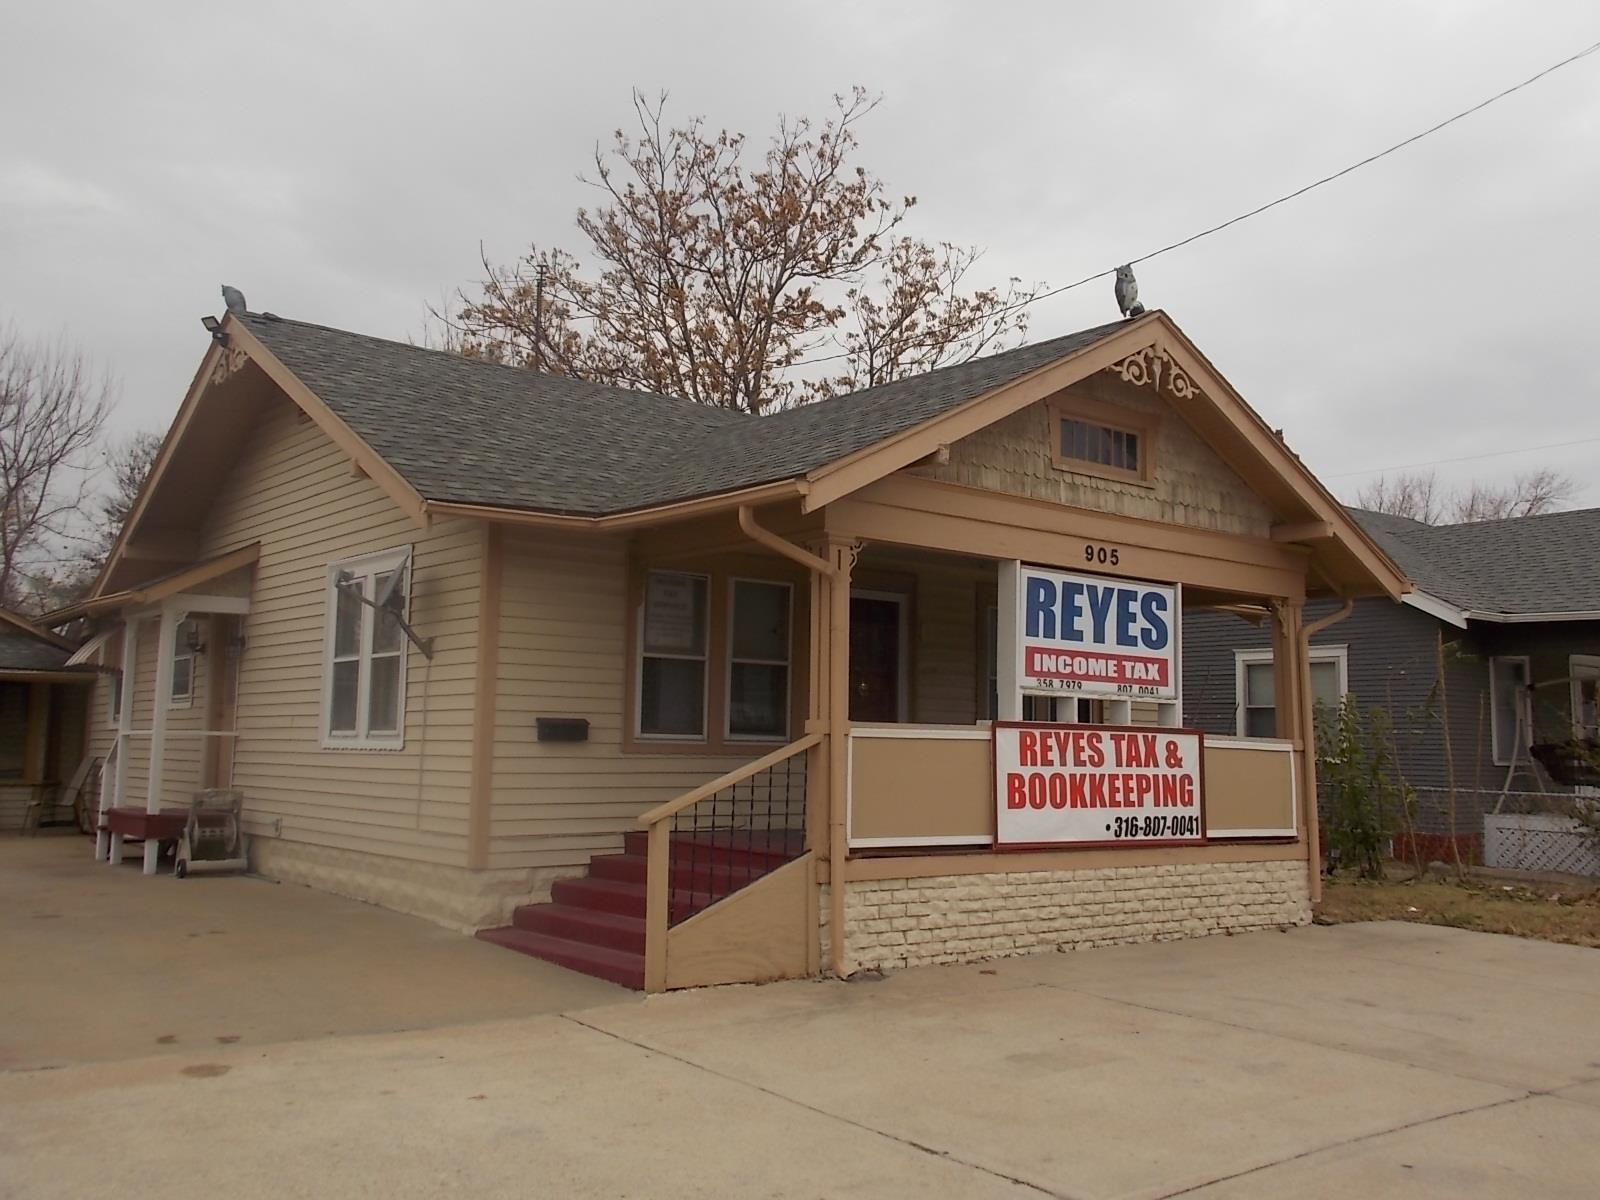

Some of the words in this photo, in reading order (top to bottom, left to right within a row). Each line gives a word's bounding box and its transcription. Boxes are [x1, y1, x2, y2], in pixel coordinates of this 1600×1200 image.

[1085, 544, 1119, 565] 905
[1025, 576, 1169, 650] REYES
[1033, 653, 1118, 678] INCOME
[1122, 661, 1160, 681] TAX
[1018, 731, 1104, 768] REYES
[1110, 734, 1160, 768] TAX
[1165, 740, 1183, 769] &
[1007, 772, 1194, 810] BOOKKEEPING
[1114, 815, 1200, 838] 316-807-0041
